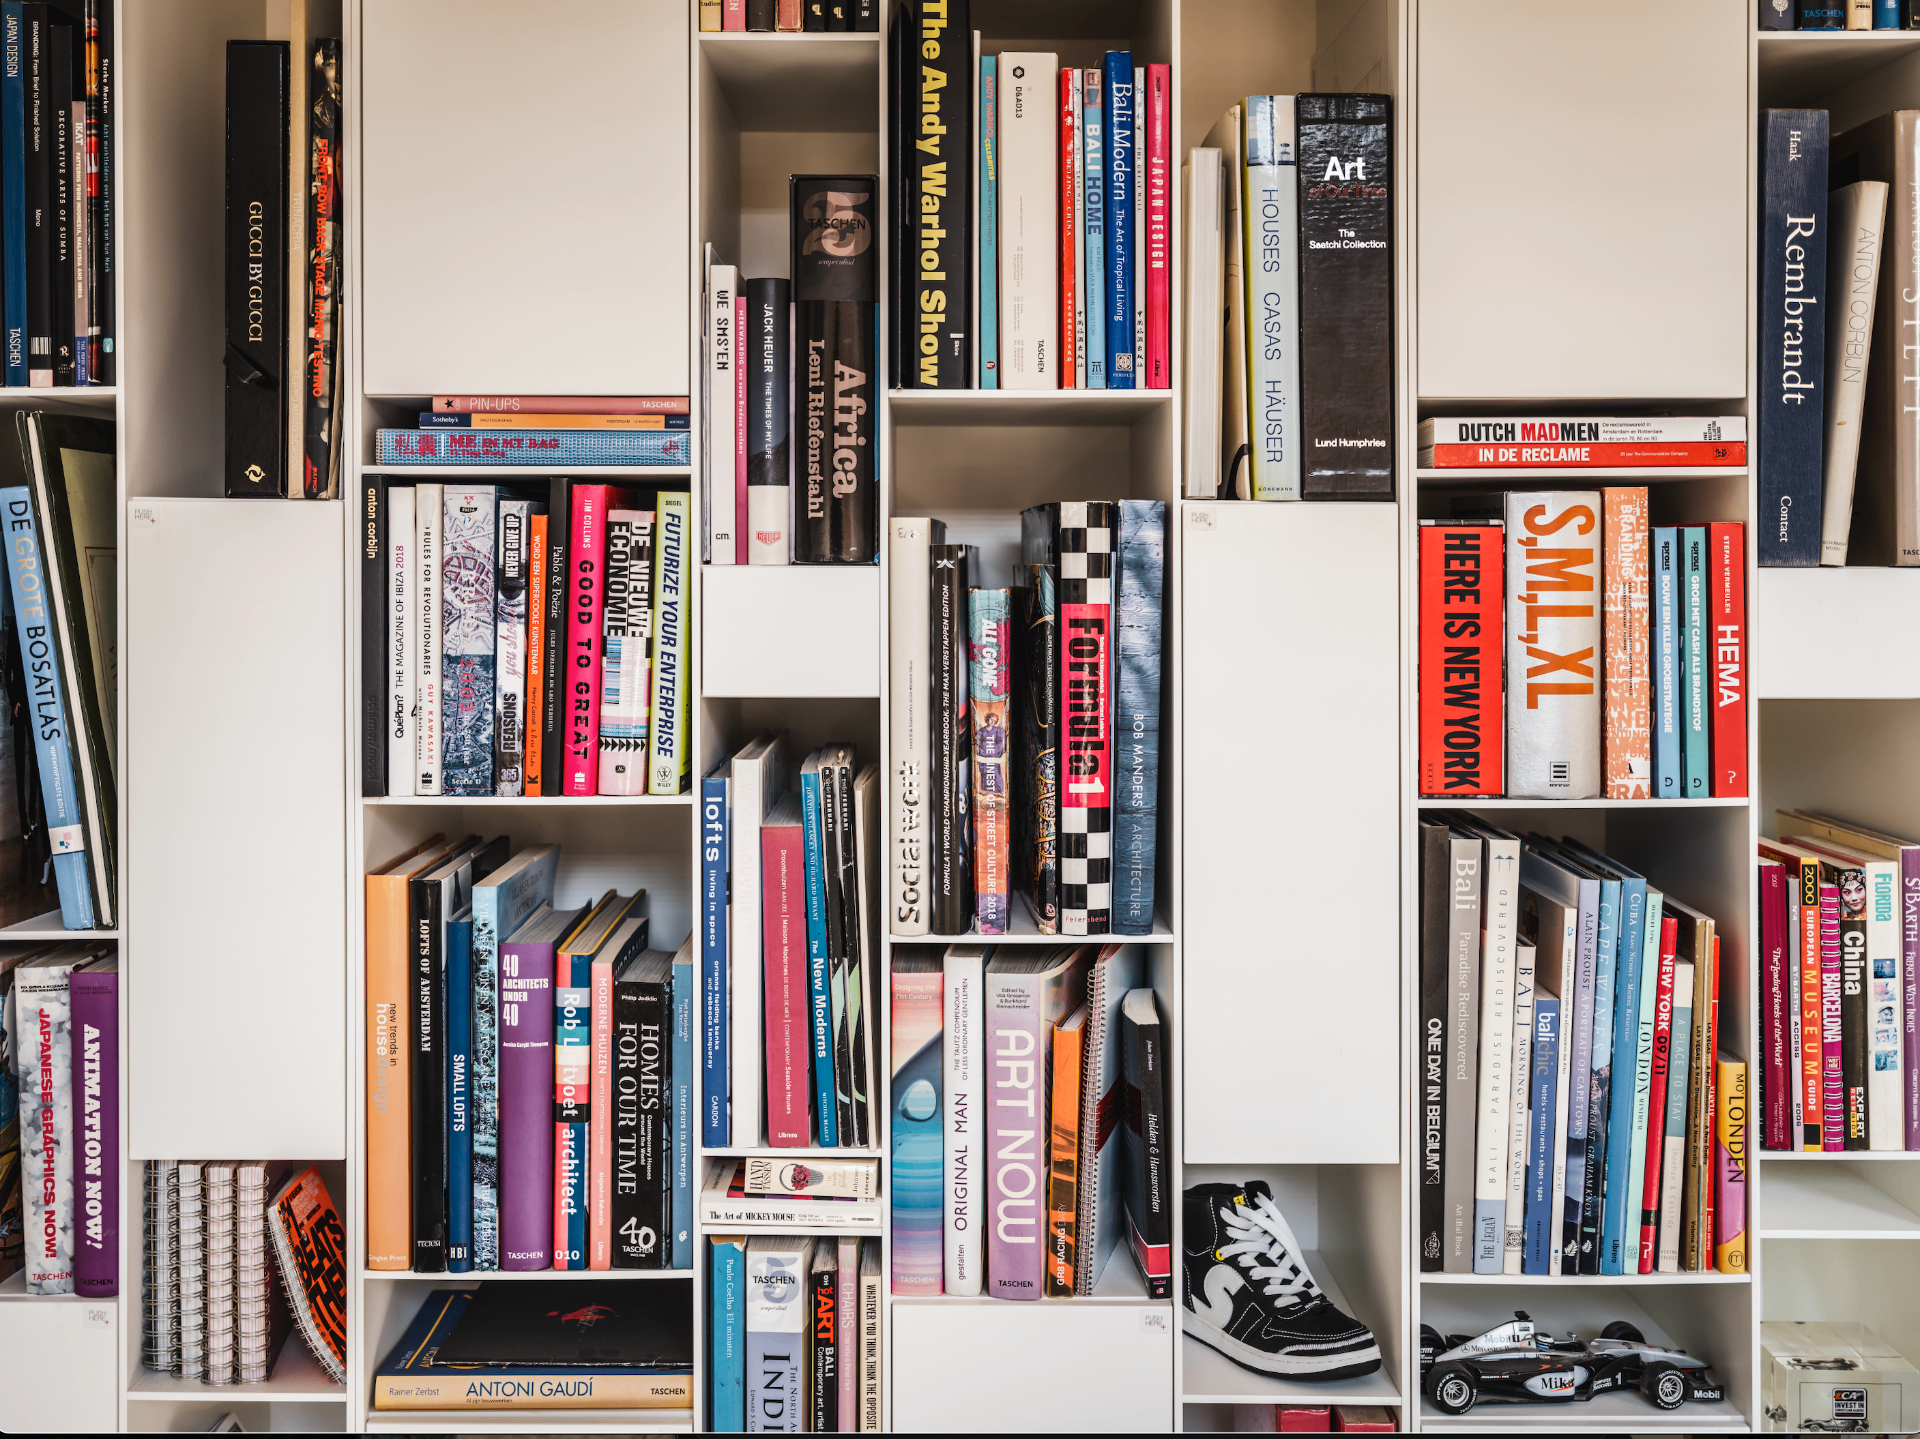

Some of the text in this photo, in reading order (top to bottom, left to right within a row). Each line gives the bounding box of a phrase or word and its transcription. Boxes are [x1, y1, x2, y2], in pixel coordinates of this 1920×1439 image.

[6, 14, 18, 76] JAPAN DESIGN
[102, 86, 110, 113] Merken
[1112, 82, 1133, 200] Bali Modern
[916, 0, 948, 386] The Andy Warhol Show
[1087, 124, 1101, 235] BALI HOME
[1324, 156, 1366, 181] Art
[59, 210, 66, 222] OF
[1151, 157, 1164, 269] JAPAN DESIGN
[1309, 239, 1386, 249] Saatchi Collection
[1338, 229, 1355, 238] The
[249, 201, 263, 342] GUCCI BY GUCCI
[9, 328, 21, 366] TASCHEN
[764, 304, 773, 372] JACK HEUER
[1263, 189, 1285, 463] HOUSES CASAS HÄUSER
[1779, 130, 1816, 542] Haak Rembrandt Contact
[433, 416, 458, 424] Sotheby's
[470, 398, 520, 411] PIN-UPS
[807, 339, 824, 519] Leni Riefenstahl
[832, 360, 866, 498] Africa
[1315, 439, 1386, 448] Lund Humphries
[1459, 423, 1599, 441] DUTCH MADMEN
[367, 488, 378, 559] anton corbijn
[8, 499, 60, 741] DE GROTE BOSATLAS
[551, 546, 563, 618] Pablo & Poëzie
[607, 521, 627, 636] ECONOMIE
[1518, 504, 1595, 709] S,M,L,XL
[574, 560, 594, 759] GOOD TO GREAT
[657, 512, 681, 758] FUTURIZE YOUR ENTERPRISE
[982, 619, 997, 687] ALL GONE
[1444, 534, 1480, 789] HERE IS NEW YORK
[1718, 625, 1739, 707] HEMA
[706, 796, 722, 862] lofts
[1130, 714, 1144, 917] BOB MANDERS ARCHITECTURE
[420, 919, 431, 1052] LOFTS OF AMSTERDAM
[1455, 858, 1476, 1080] Bali Paradise Rediscovered
[1804, 867, 1818, 1111] 2000 EUROPEAN MUSEUM GUIDE
[1844, 931, 1864, 995] China
[598, 978, 607, 1074] MODERNE HUIZEN
[813, 958, 827, 1058] New Moderns
[1655, 954, 1673, 1075] NEW YORK 09/11
[1822, 973, 1841, 1042] BARCELONA
[453, 1054, 465, 1131] SMALL LOFTS
[641, 1023, 659, 1110] HOMES
[1426, 1018, 1441, 1170] ONE DAY IN BELGIUM
[1637, 1021, 1653, 1094] LONDON
[38, 1008, 56, 1258] JAPANESE GRAPHICS NOW!
[84, 1024, 102, 1249] ANIMATION NOW!
[618, 1022, 636, 1194] FOR OUR TIME
[996, 1029, 1036, 1243] ART NOW
[1856, 1087, 1864, 1137] EXPERT
[562, 1128, 578, 1215] architect
[955, 1093, 968, 1231] ORIGINAL MAN
[1148, 1114, 1160, 1212] Helden & Hansworsten
[745, 1212, 771, 1220] MICKEY
[1611, 1240, 1619, 1263] Librero
[817, 1295, 834, 1343] ART
[842, 1283, 854, 1328] CHAIRS
[466, 1382, 533, 1396] ANTONI
[540, 1376, 593, 1396] GAUDÍ
[1615, 1373, 1621, 1384] 1
[1694, 1390, 1719, 1398] Mobil
